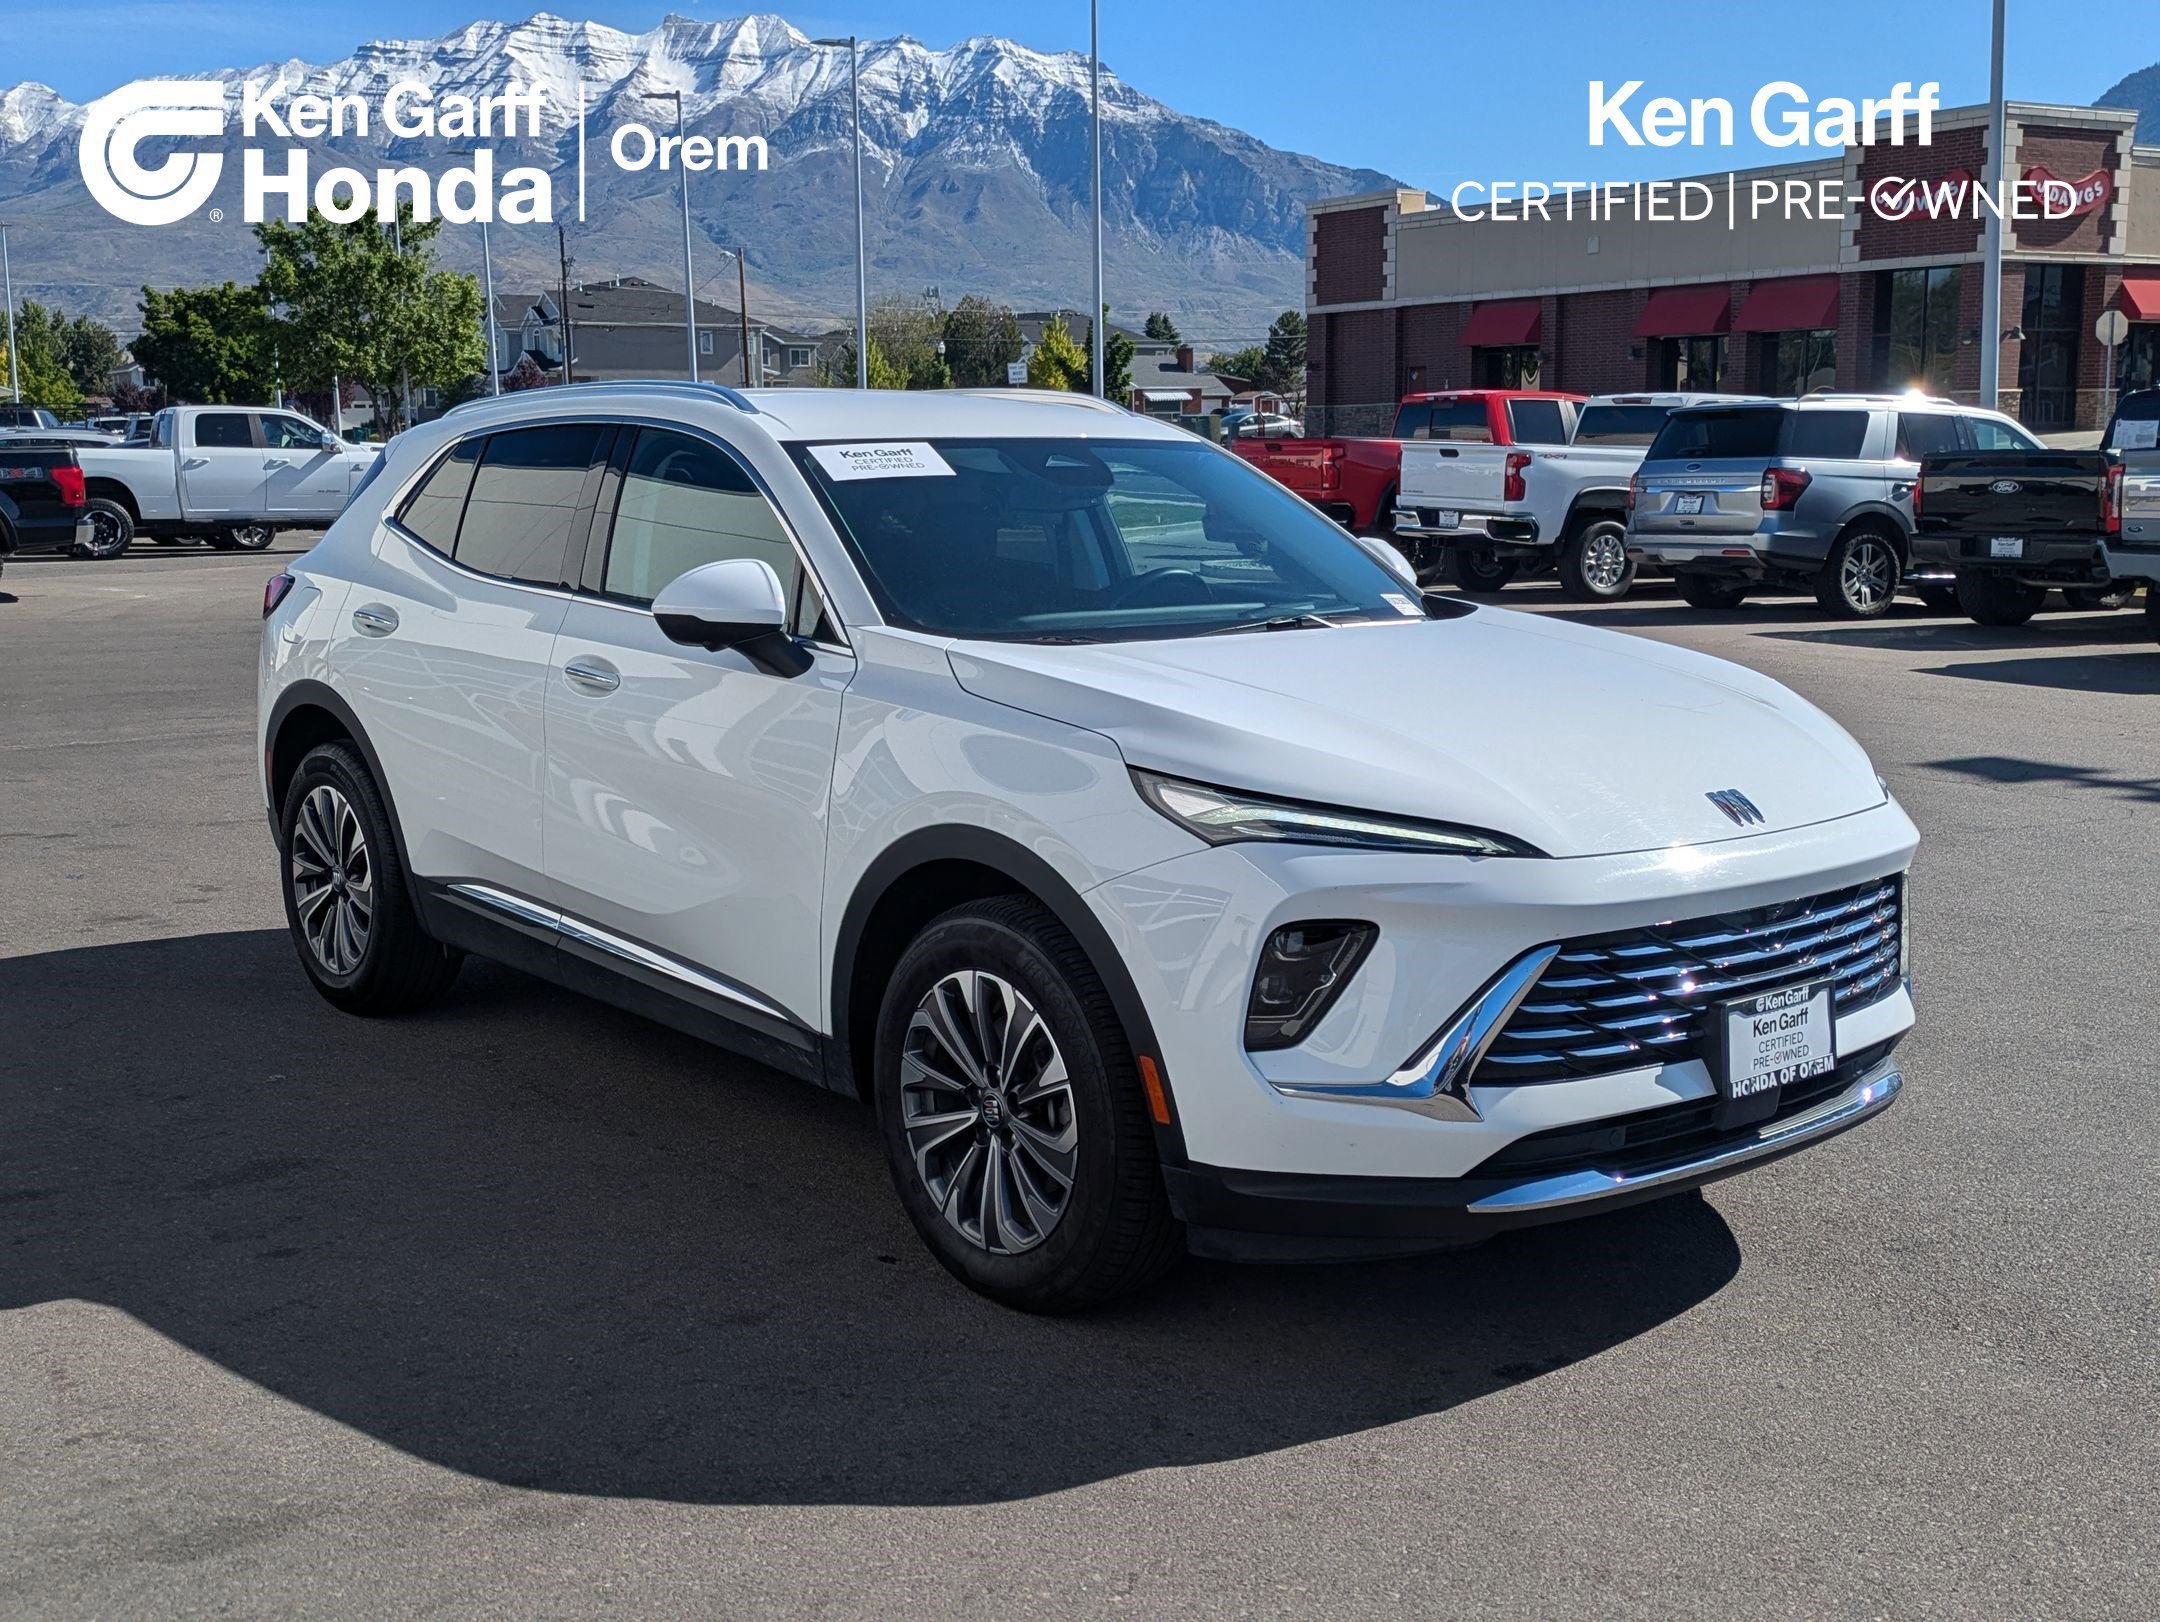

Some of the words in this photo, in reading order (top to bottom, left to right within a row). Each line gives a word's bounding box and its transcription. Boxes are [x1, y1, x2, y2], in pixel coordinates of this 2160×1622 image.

[839, 450, 873, 459] Ken
[874, 447, 914, 458] Garff
[854, 457, 914, 465] CERTIFIED
[1765, 994, 1785, 1009] Ken
[1785, 986, 1810, 1002] Garff
[1753, 1018, 1777, 1038] Ken
[1779, 1007, 1809, 1031] Garff
[1758, 1031, 1804, 1054] CERTIFIED
[1753, 1044, 1810, 1071] PRE-OWNED
[1732, 1073, 1778, 1099] HONDA
[1780, 1065, 1796, 1084] OF
